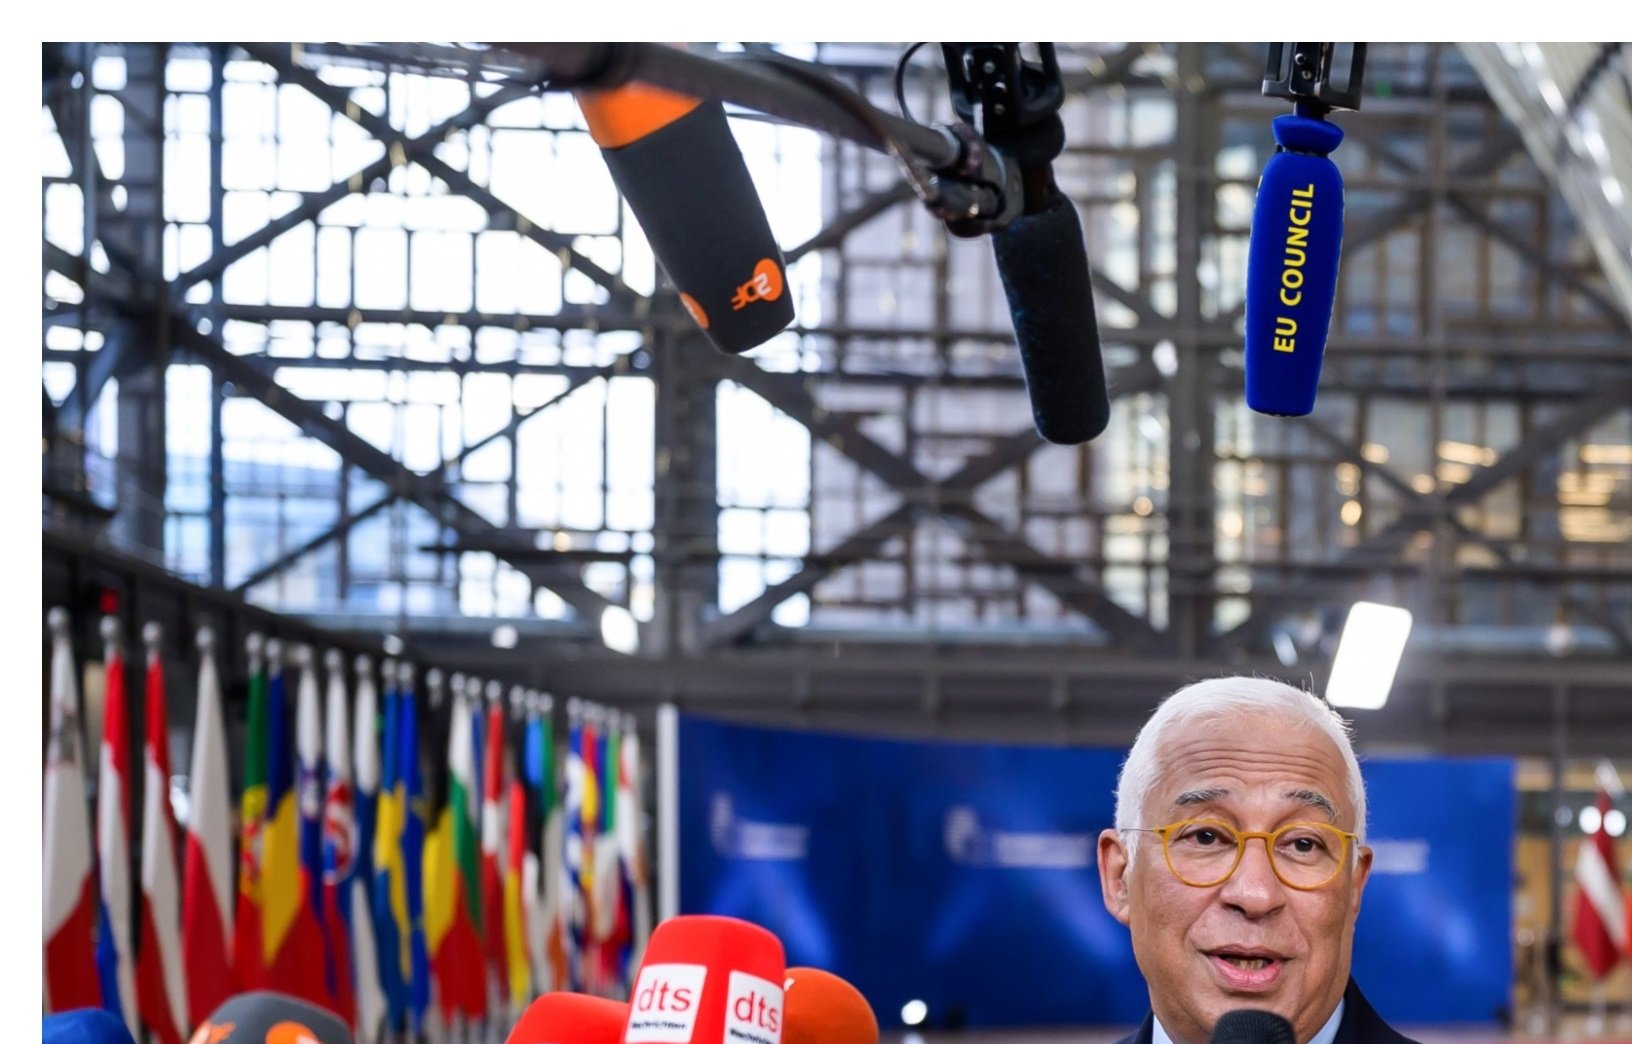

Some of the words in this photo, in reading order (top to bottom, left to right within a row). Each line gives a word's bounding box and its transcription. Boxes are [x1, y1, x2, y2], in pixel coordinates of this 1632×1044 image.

[1280, 184, 1314, 306] COUNCIL
[1273, 317, 1297, 353] EU
[638, 979, 692, 1012] dts
[735, 991, 779, 1032] dts
